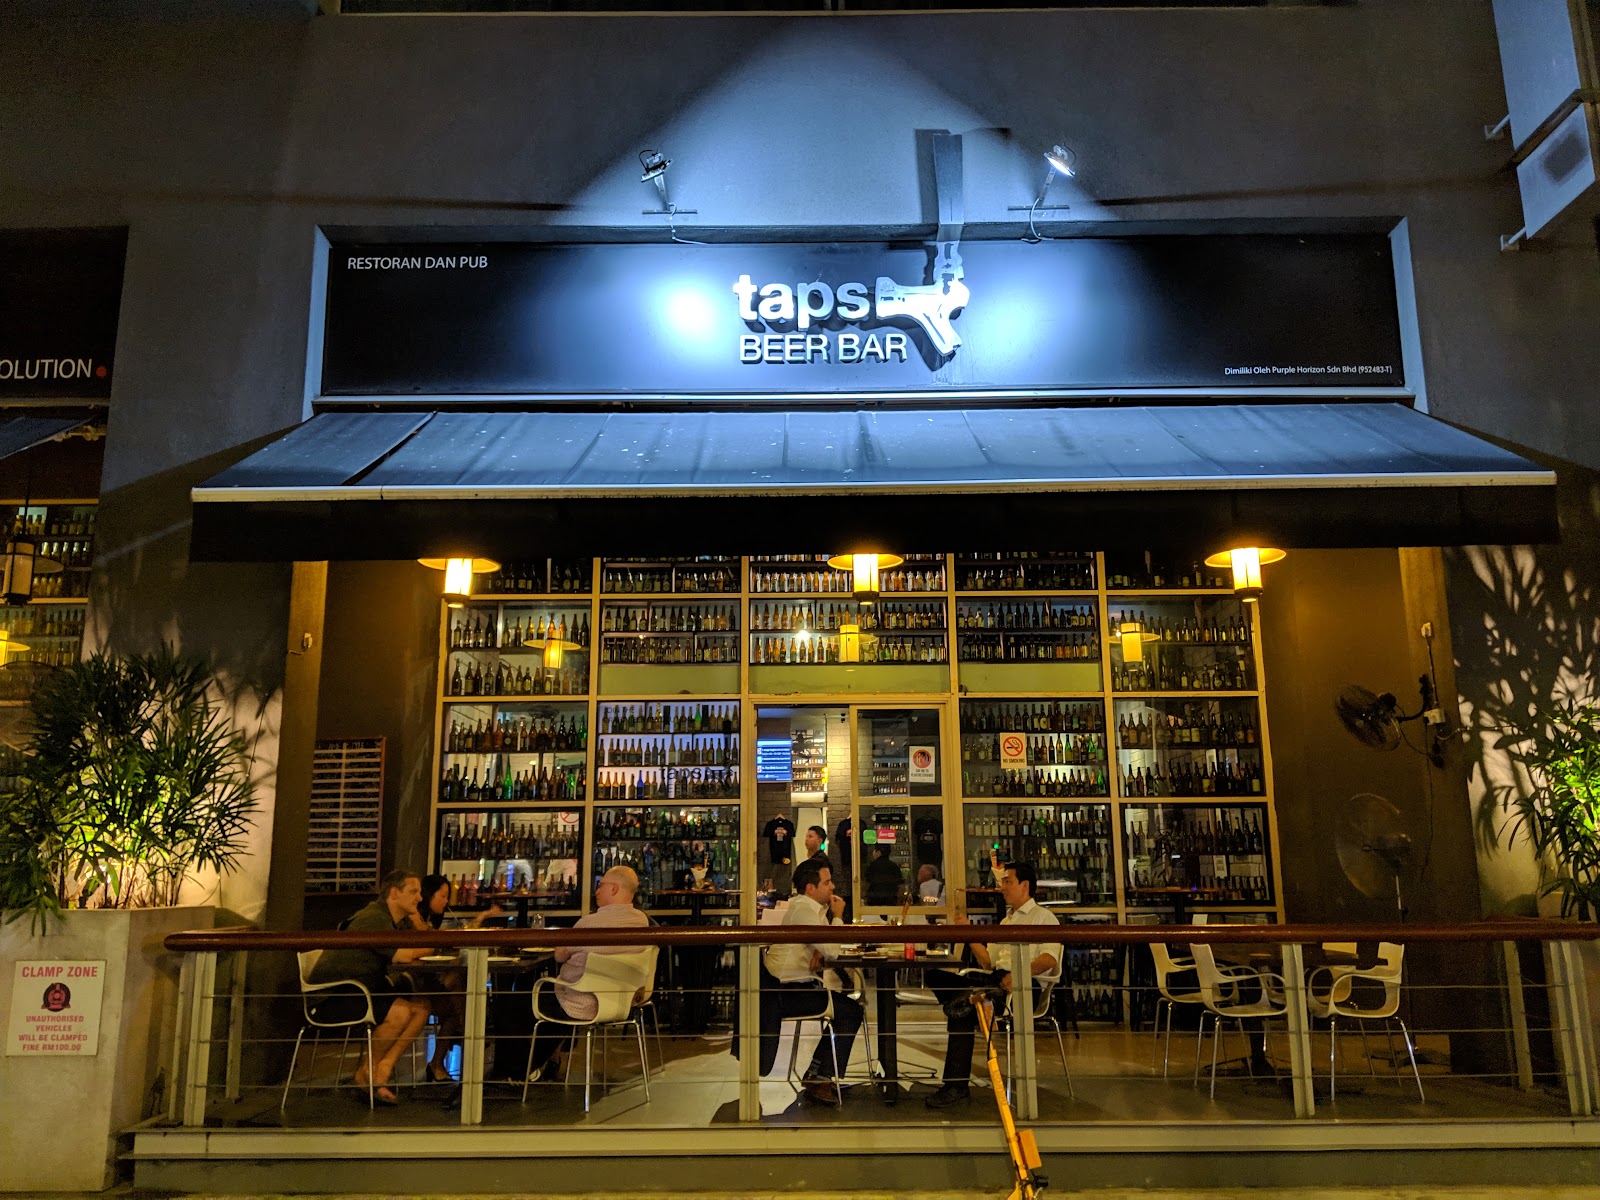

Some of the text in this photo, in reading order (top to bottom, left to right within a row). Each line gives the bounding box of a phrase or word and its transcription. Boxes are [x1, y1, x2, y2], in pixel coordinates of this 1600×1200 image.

[347, 256, 489, 270] RESTORAN DAN PUB
[732, 274, 870, 331] taps
[739, 333, 907, 361] BEER BAR
[0, 358, 93, 379] OLUTION
[1224, 367, 1252, 375] Dimiliki
[1253, 366, 1271, 375] Oleh
[1272, 366, 1296, 376] Purple
[1297, 366, 1326, 374] Horizon
[1326, 366, 1341, 374] Sdn
[1342, 366, 1357, 374] Bhd
[21, 966, 98, 978] CLAMP ZONE
[25, 1015, 85, 1023] UNAUTHORISED
[35, 1024, 73, 1032] VEHICLES
[18, 1034, 37, 1042] WILL
[22, 1043, 82, 1051] FINE RM100.00
